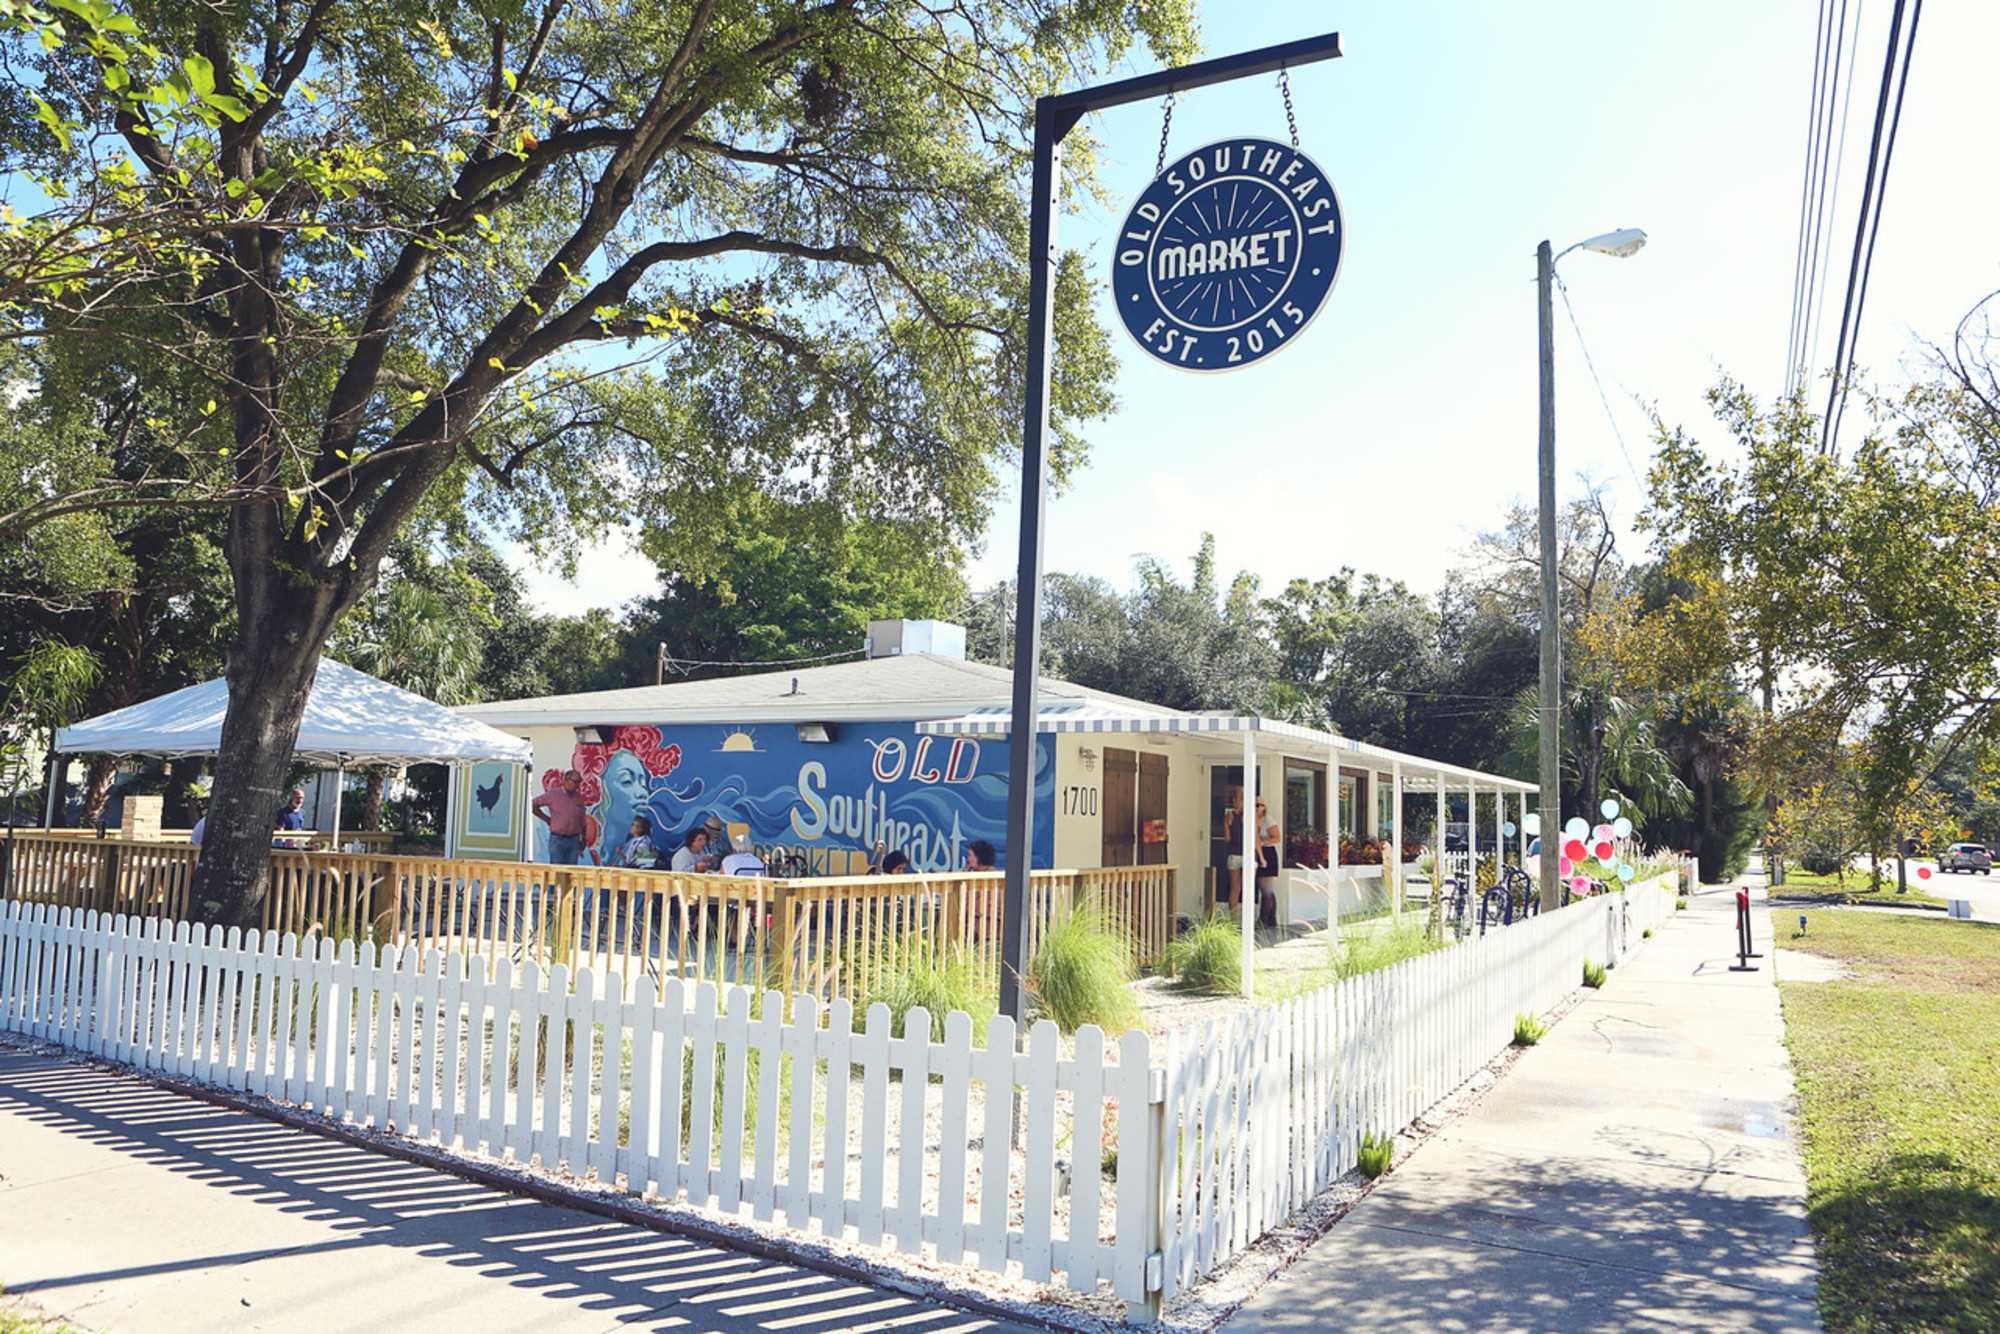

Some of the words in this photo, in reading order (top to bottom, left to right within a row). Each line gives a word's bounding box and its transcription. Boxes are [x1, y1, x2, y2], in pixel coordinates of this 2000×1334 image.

[1120, 202, 1161, 266] OLD
[1166, 145, 1335, 235] SOUTHEAST
[1158, 229, 1292, 281] MARKET
[1143, 317, 1204, 363] EST.
[1227, 301, 1304, 362] 2015
[864, 736, 980, 784] OLD
[1063, 786, 1098, 816] 1700
